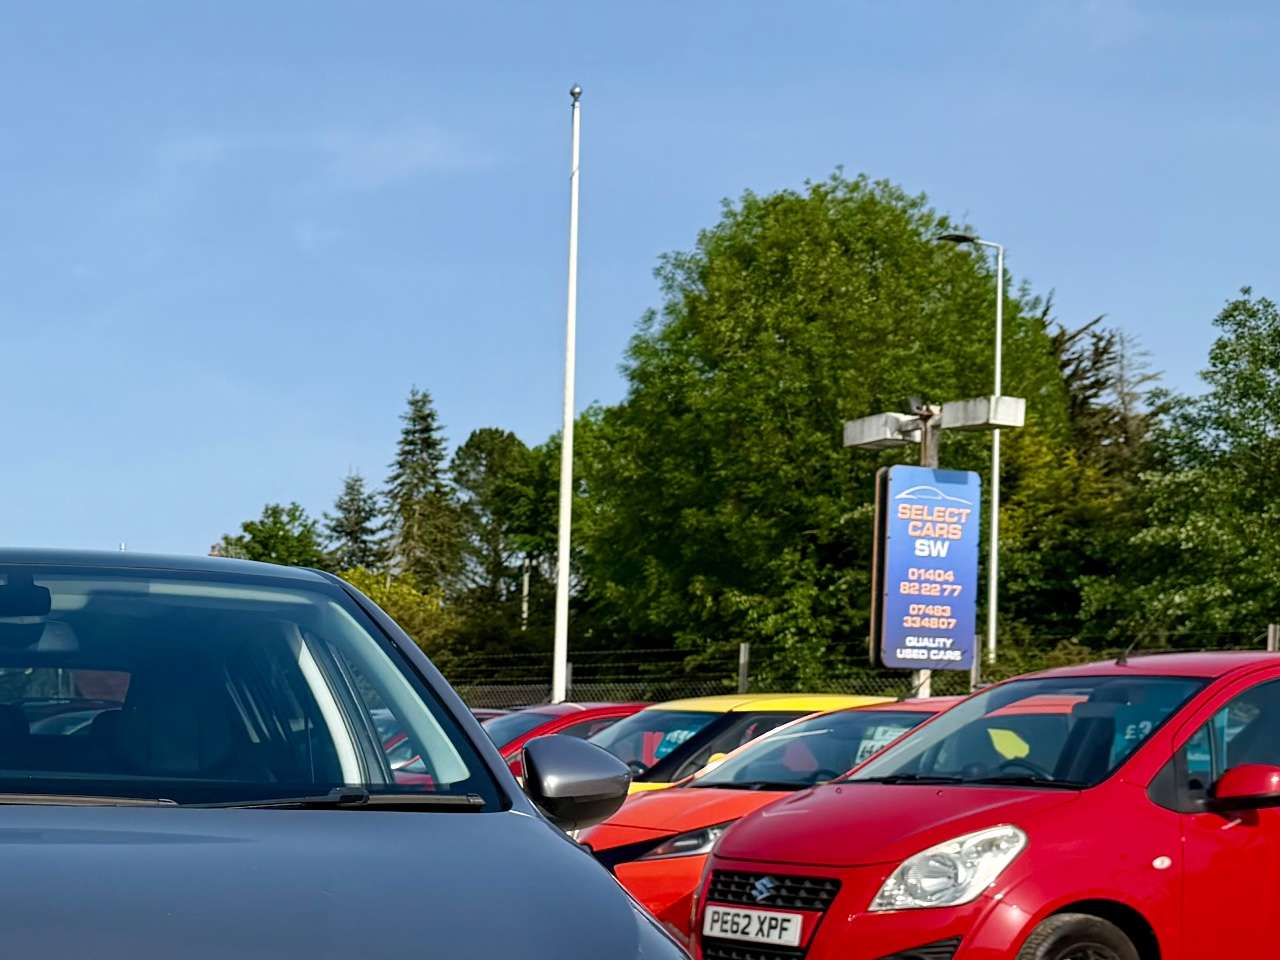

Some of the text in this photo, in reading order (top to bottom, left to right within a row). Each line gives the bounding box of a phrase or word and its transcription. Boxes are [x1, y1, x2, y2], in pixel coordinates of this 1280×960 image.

[898, 504, 971, 523] SELECT
[908, 521, 962, 539] CARS
[915, 540, 950, 557] SW
[908, 568, 954, 582] 01404
[905, 636, 952, 648] QUALITY
[896, 648, 963, 661] USED CARS
[709, 910, 791, 940] PE62 XPF
